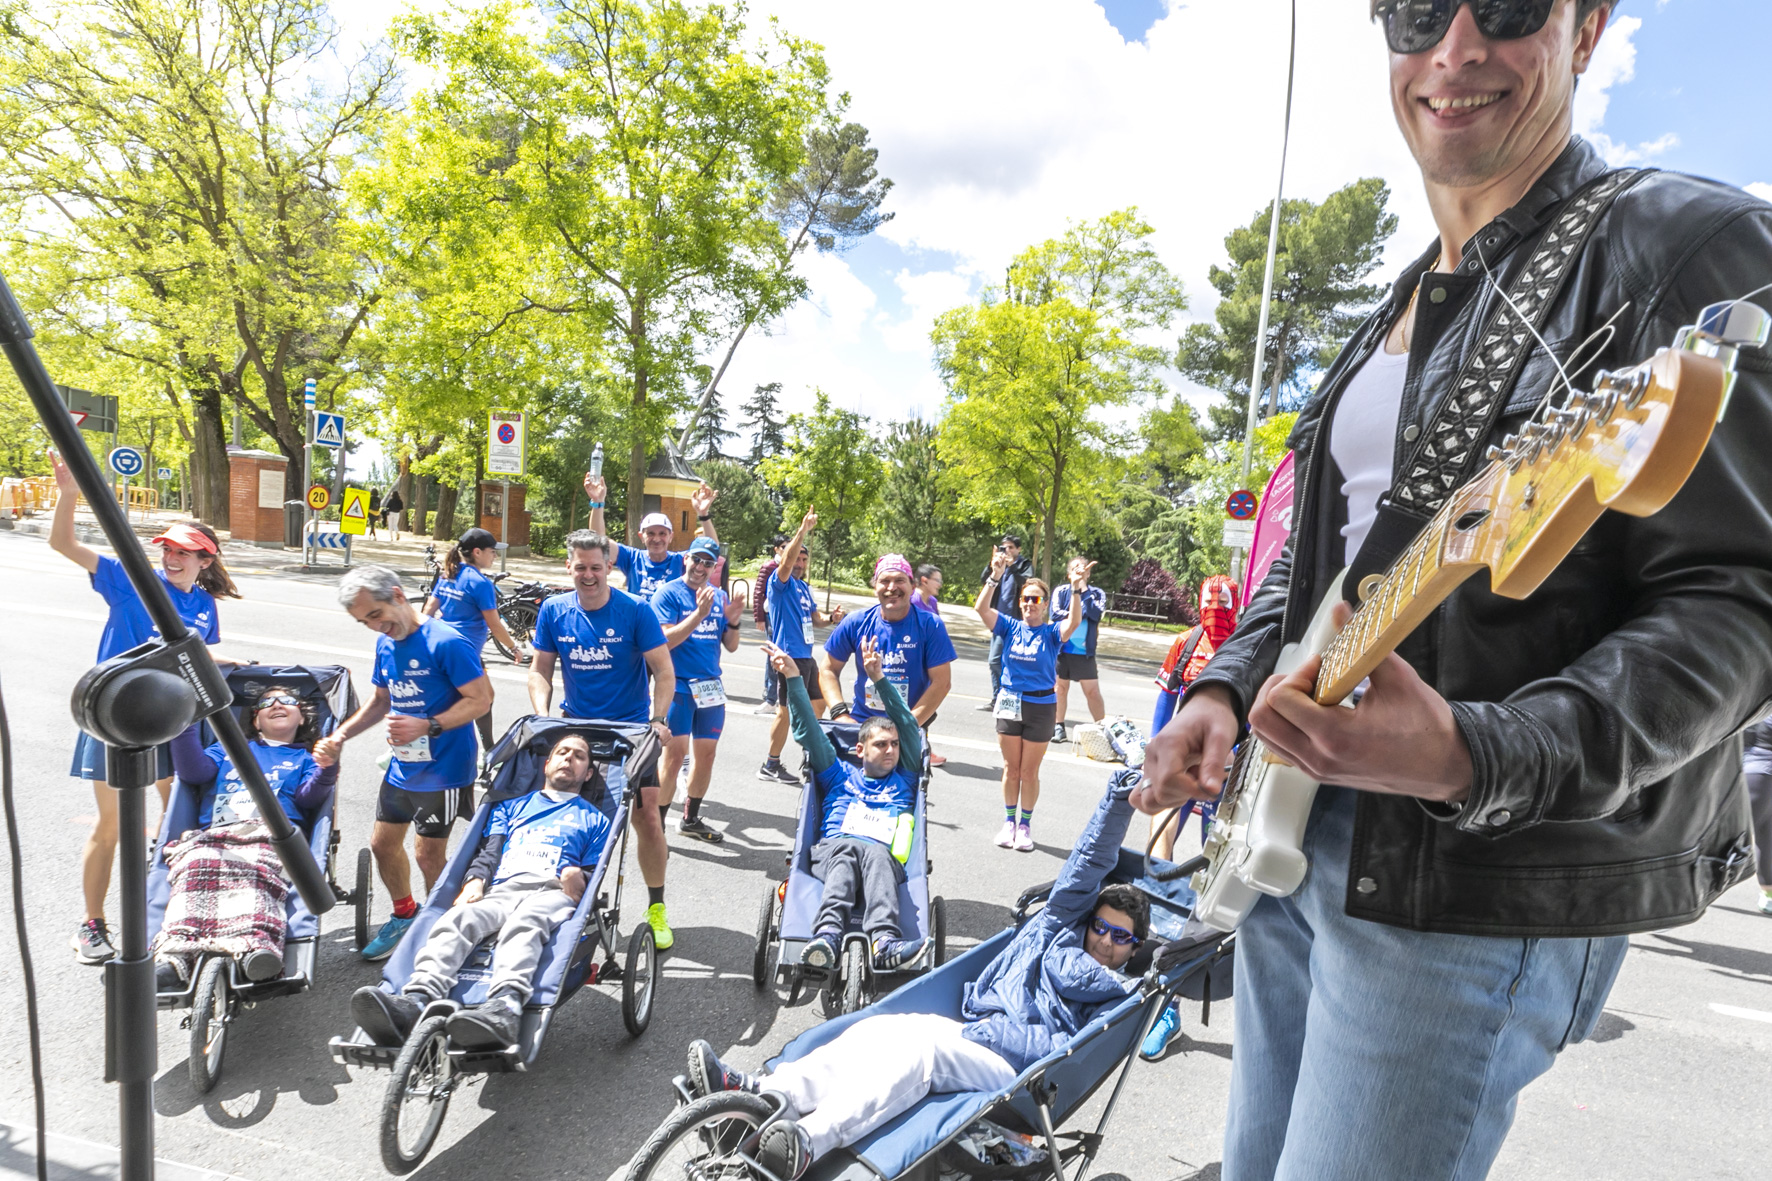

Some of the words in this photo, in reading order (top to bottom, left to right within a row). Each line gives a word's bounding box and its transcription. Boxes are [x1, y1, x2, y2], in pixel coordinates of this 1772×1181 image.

[313, 491, 325, 503] 20
[571, 663, 612, 671] #imparables
[403, 669, 430, 677] ZURICH
[184, 662, 214, 708] SENNHEISER
